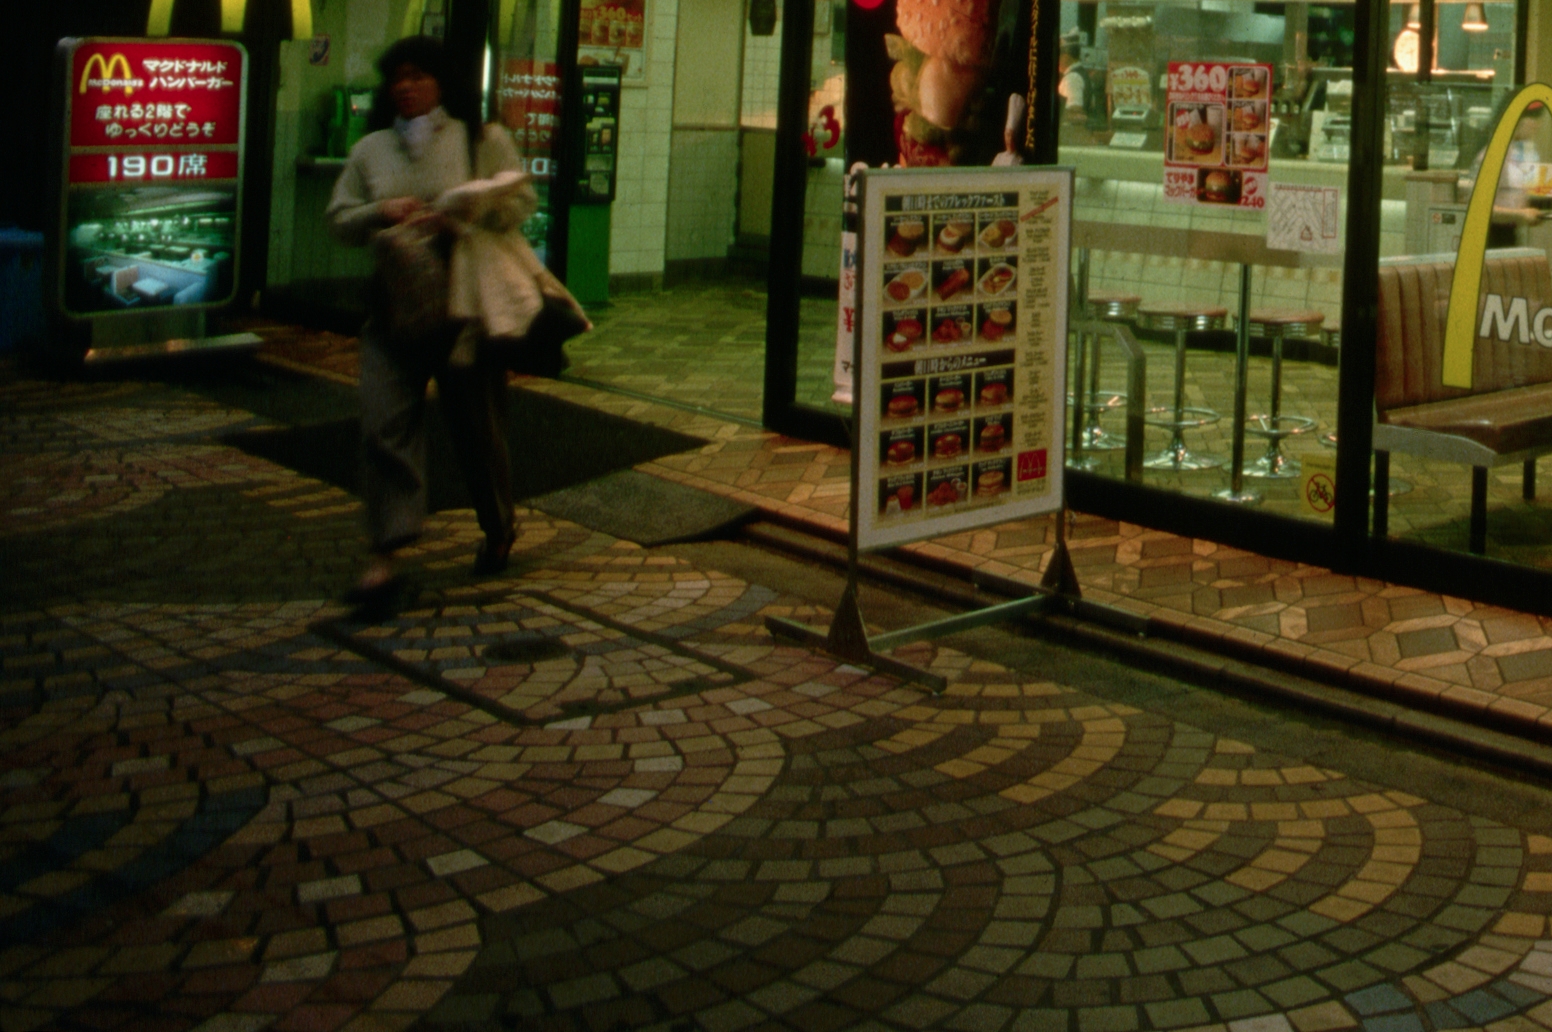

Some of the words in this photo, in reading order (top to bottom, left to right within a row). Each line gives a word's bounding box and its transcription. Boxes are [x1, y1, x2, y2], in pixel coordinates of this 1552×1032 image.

[143, 58, 228, 74] マクドナルド
[149, 76, 234, 90] ハンバーガー
[95, 103, 192, 121] 座れる2階で
[105, 121, 216, 139] ゆっくりどうぞ
[107, 154, 208, 178] 190席
